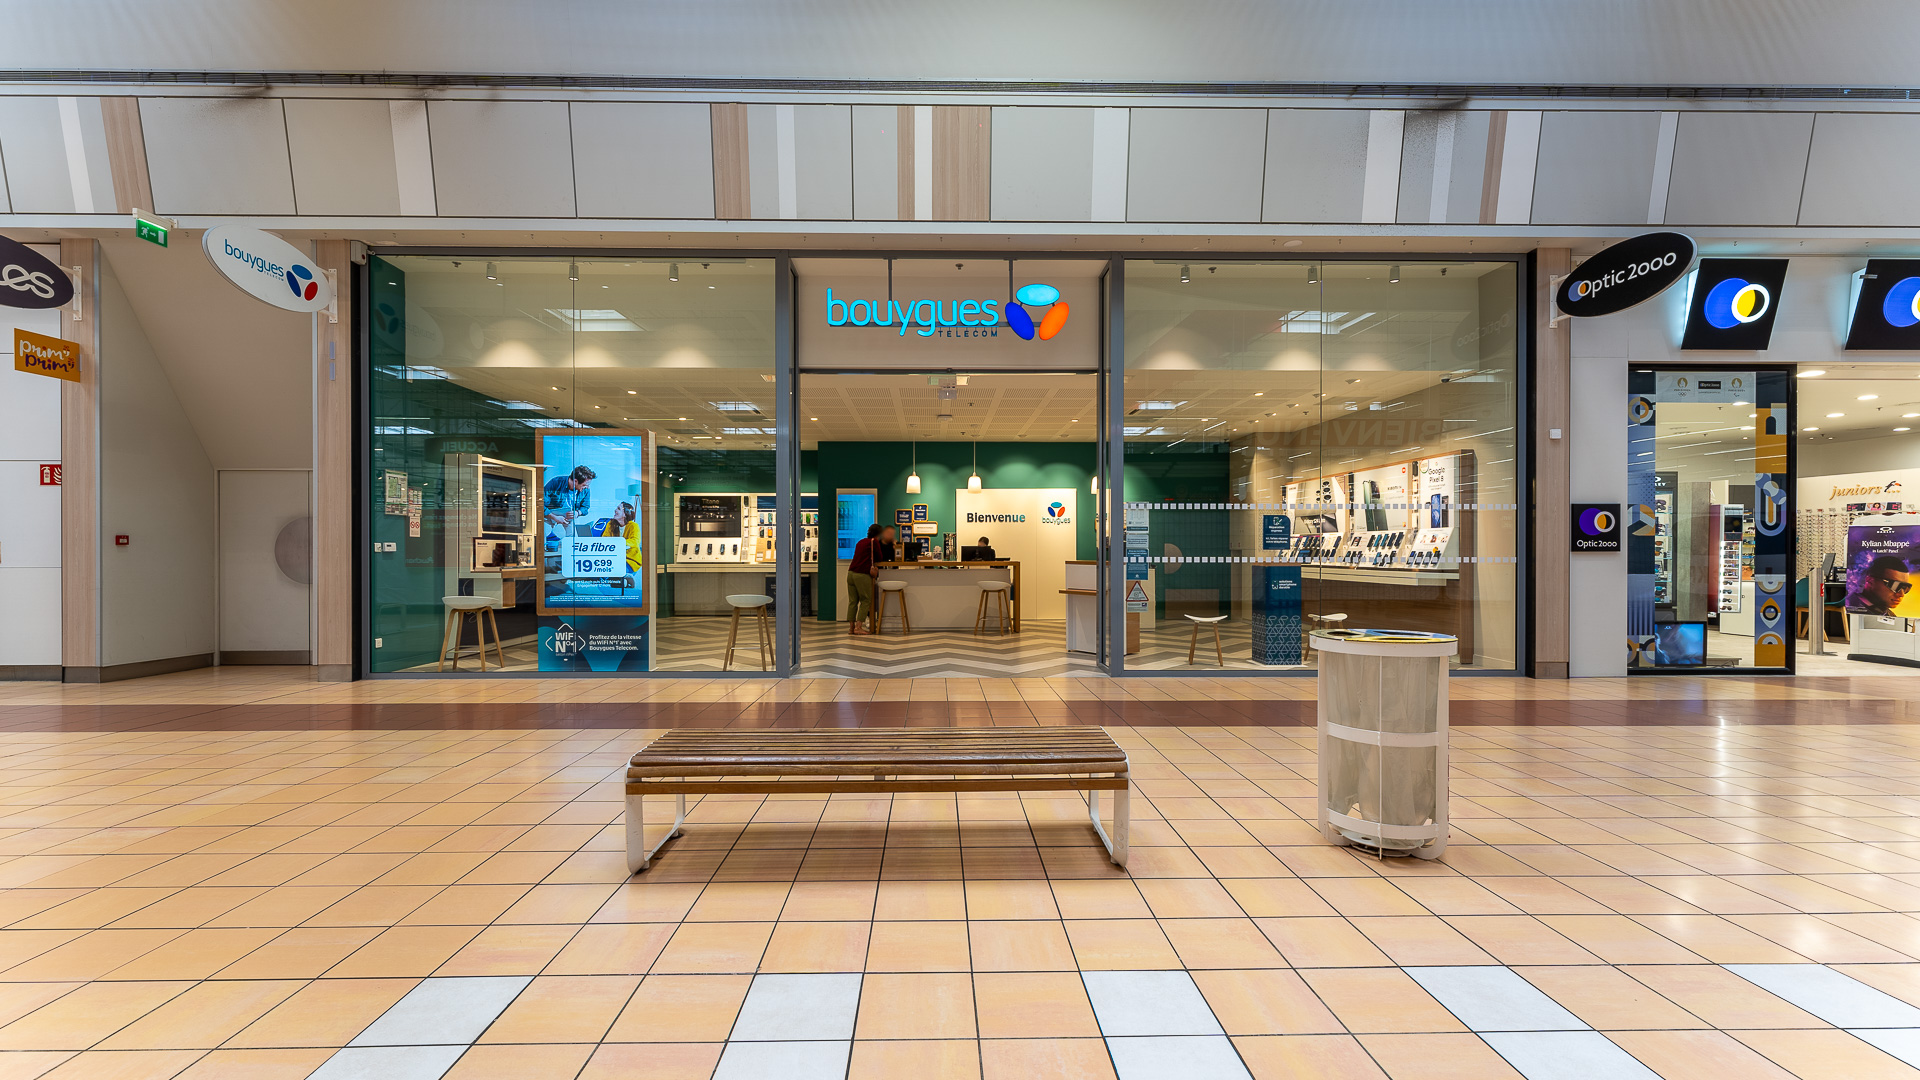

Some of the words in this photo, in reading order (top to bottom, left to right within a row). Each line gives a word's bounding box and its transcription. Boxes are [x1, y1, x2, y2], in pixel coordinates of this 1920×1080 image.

[224, 238, 284, 277] bouygues
[1578, 270, 1625, 298] Optic
[1627, 252, 1676, 280] 2000
[0, 264, 54, 299] es
[826, 288, 1000, 336] bouygues
[1428, 466, 1445, 475] Google
[1829, 484, 1882, 500] juniors
[966, 512, 1026, 523] Bienvenue
[1042, 516, 1070, 525] bouygues
[590, 543, 616, 551] fibre
[1576, 540, 1598, 548] Optic
[1883, 540, 1910, 548] Mbappé
[576, 560, 592, 572] 19
[555, 632, 576, 640] WiFi
